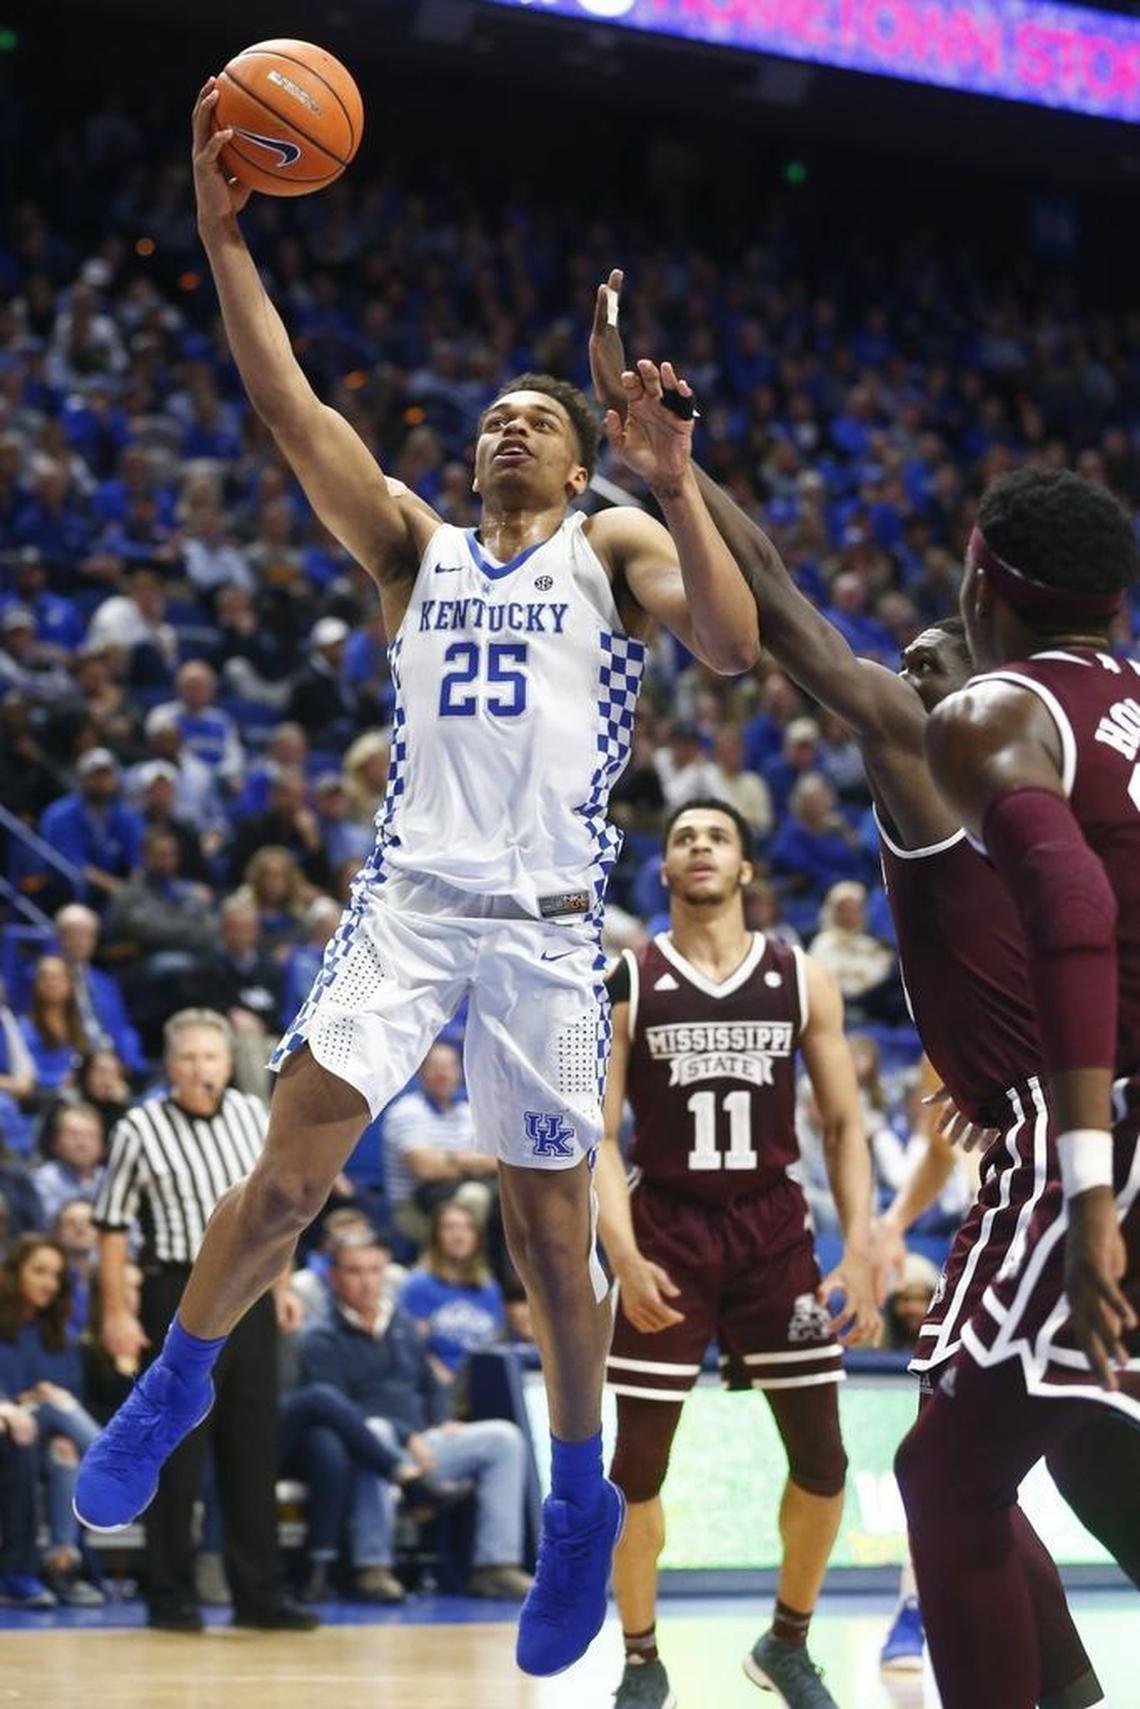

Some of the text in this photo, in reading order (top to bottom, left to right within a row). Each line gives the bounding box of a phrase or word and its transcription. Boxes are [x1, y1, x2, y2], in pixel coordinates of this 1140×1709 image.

[535, 576, 553, 591] SEC
[418, 598, 569, 634] KENTUCKY
[438, 641, 529, 717] 25
[648, 1026, 792, 1055] MISSISSIPPI
[687, 1053, 754, 1078] STATE
[524, 1111, 575, 1157] UK
[687, 1090, 758, 1171] 11
